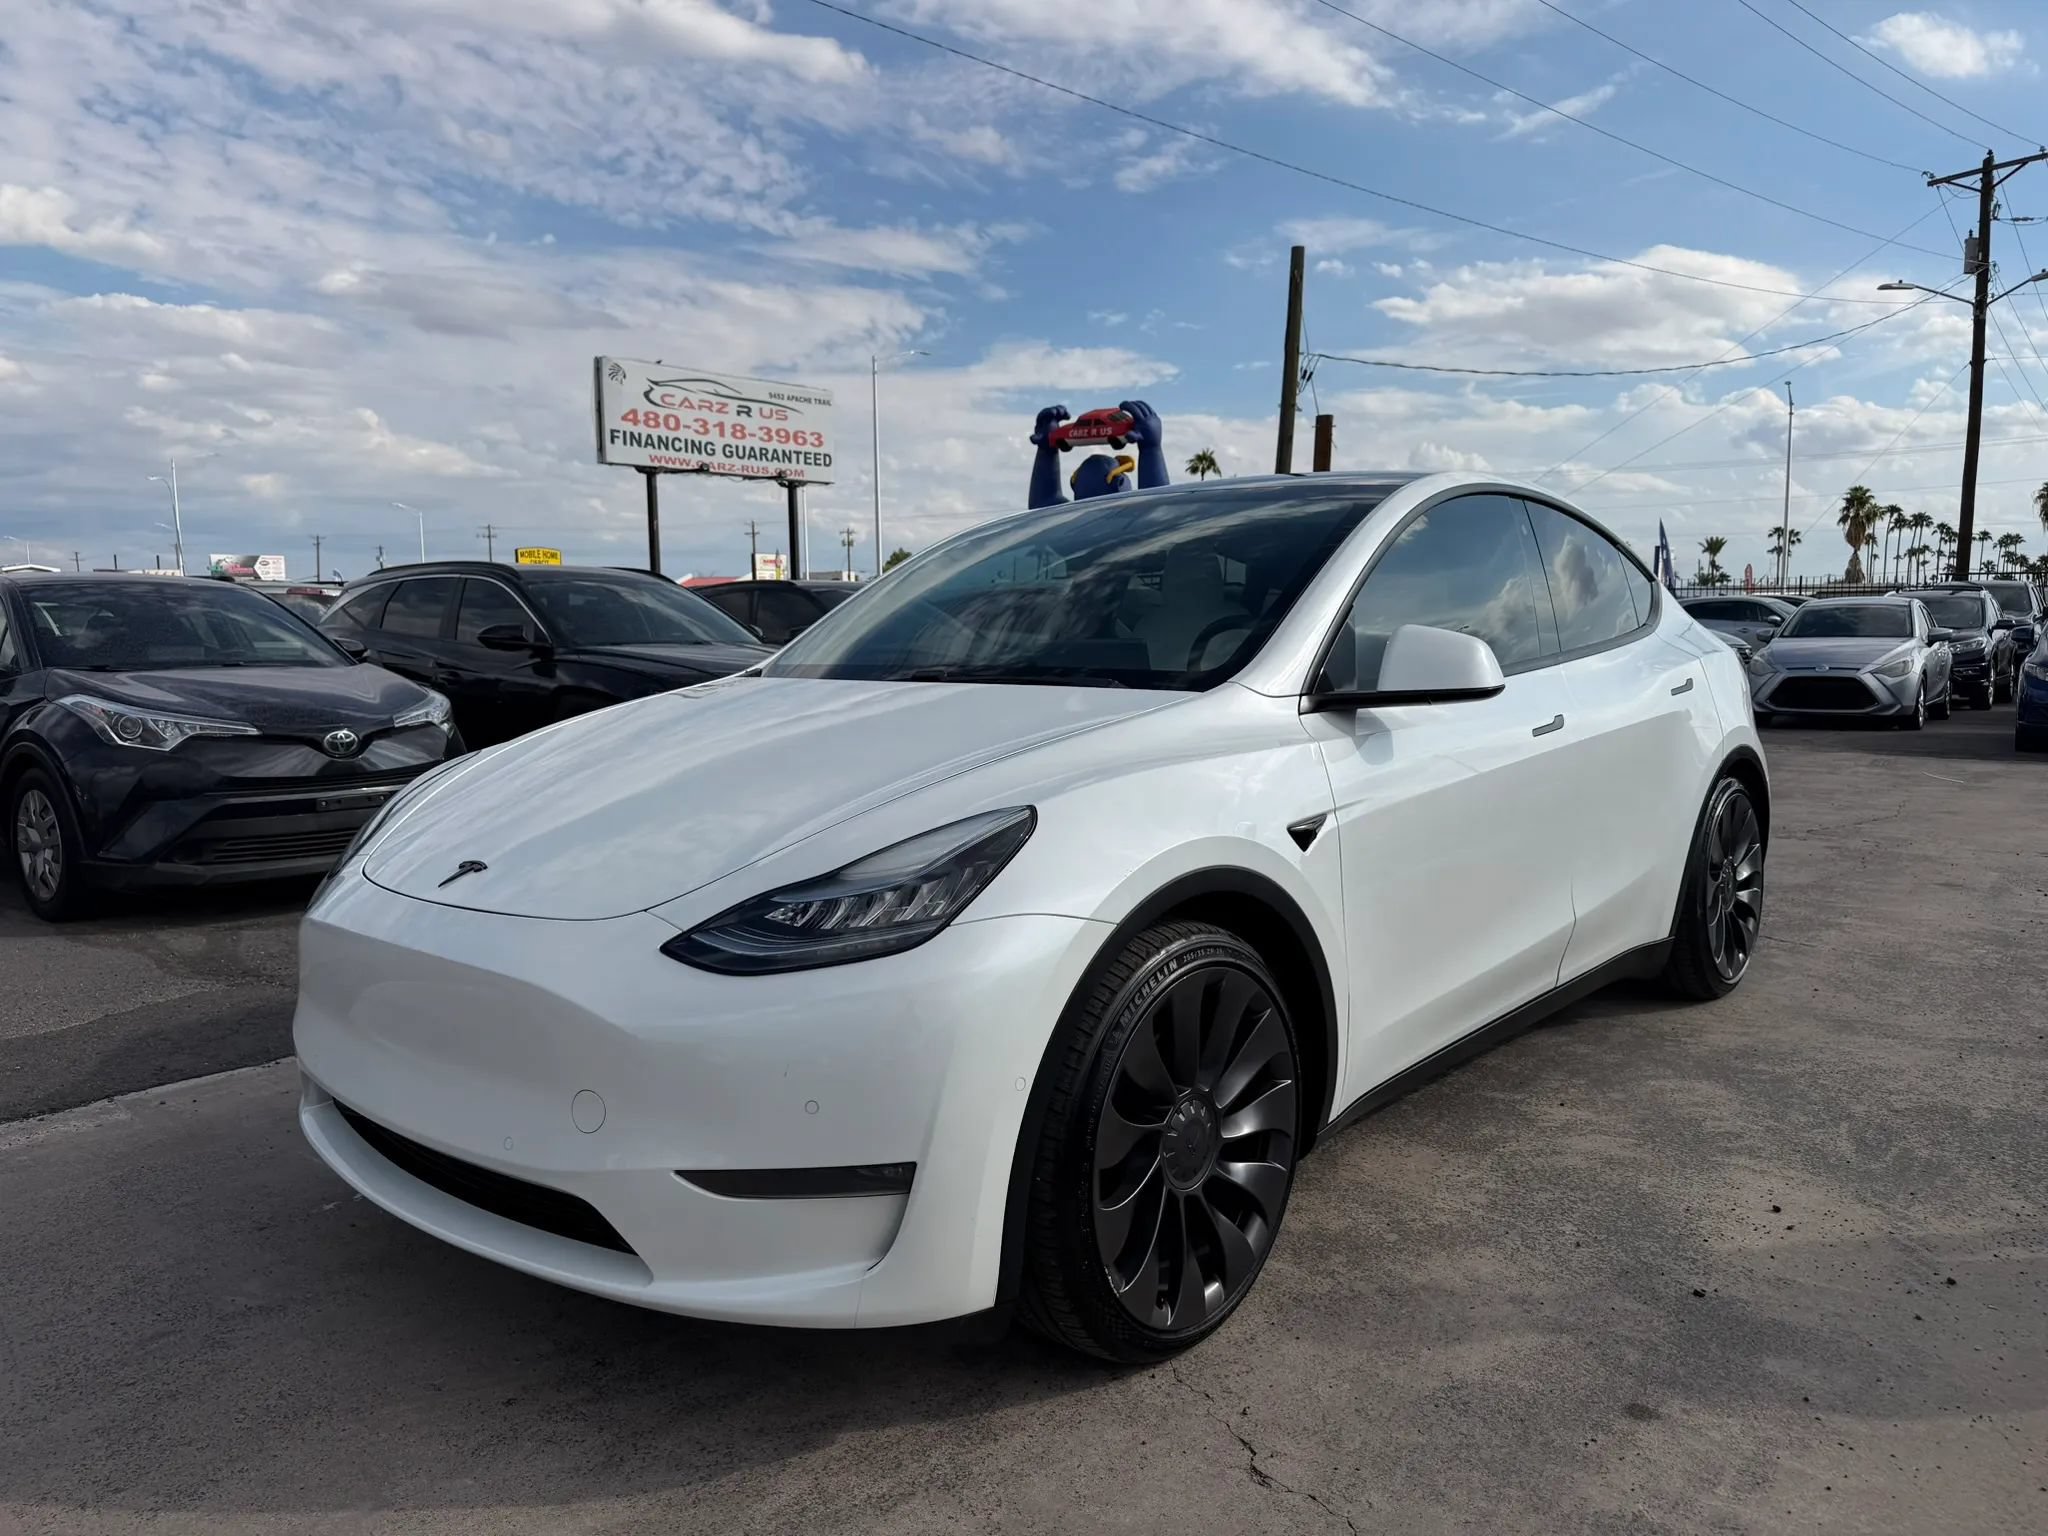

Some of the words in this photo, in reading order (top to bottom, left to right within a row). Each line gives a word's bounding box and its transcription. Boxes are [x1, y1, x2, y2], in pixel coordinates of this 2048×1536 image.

[660, 393, 729, 415] CARZ
[736, 404, 752, 418] R
[759, 406, 788, 421] US
[787, 395, 812, 404] APACHE
[814, 398, 832, 406] TRAIL
[621, 408, 824, 448] 480-318-3963
[1100, 427, 1112, 436] US
[610, 428, 716, 458] FINANCING
[722, 443, 832, 468] GUARANTEED
[519, 549, 541, 559] MOBILE
[1119, 958, 1178, 1027] MICHELIN
